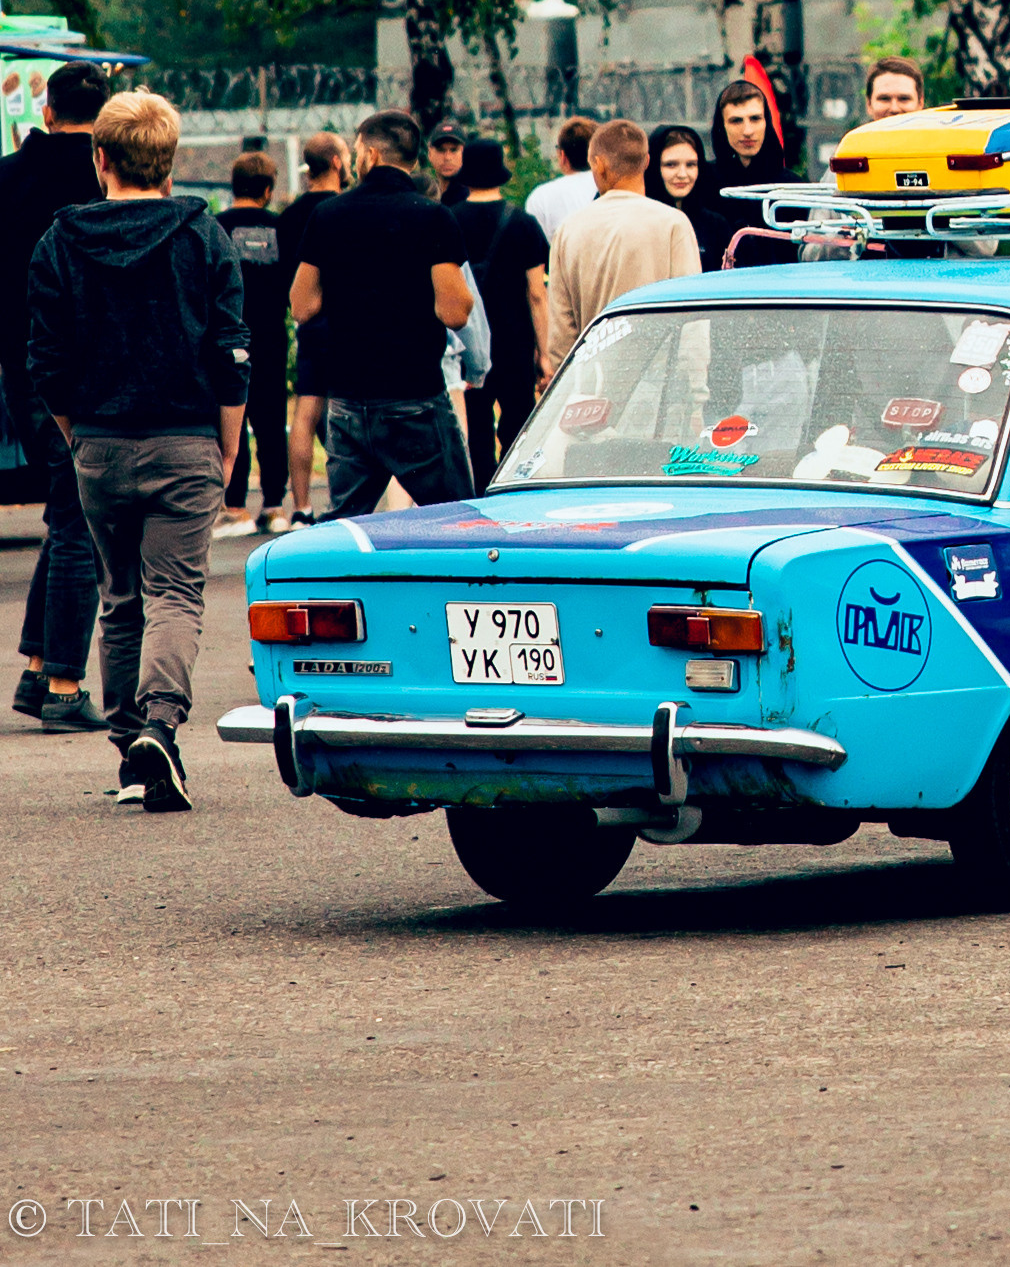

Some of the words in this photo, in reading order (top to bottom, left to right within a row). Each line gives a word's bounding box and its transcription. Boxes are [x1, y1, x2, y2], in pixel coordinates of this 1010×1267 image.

[564, 406, 601, 420] STOP
[889, 405, 933, 418] STOP
[669, 443, 760, 466] Workshop
[463, 608, 480, 639] У
[491, 609, 540, 639] 970
[300, 662, 347, 673] LADA
[461, 648, 502, 679] УК
[517, 648, 555, 671] 190
[527, 672, 545, 681] RUS
